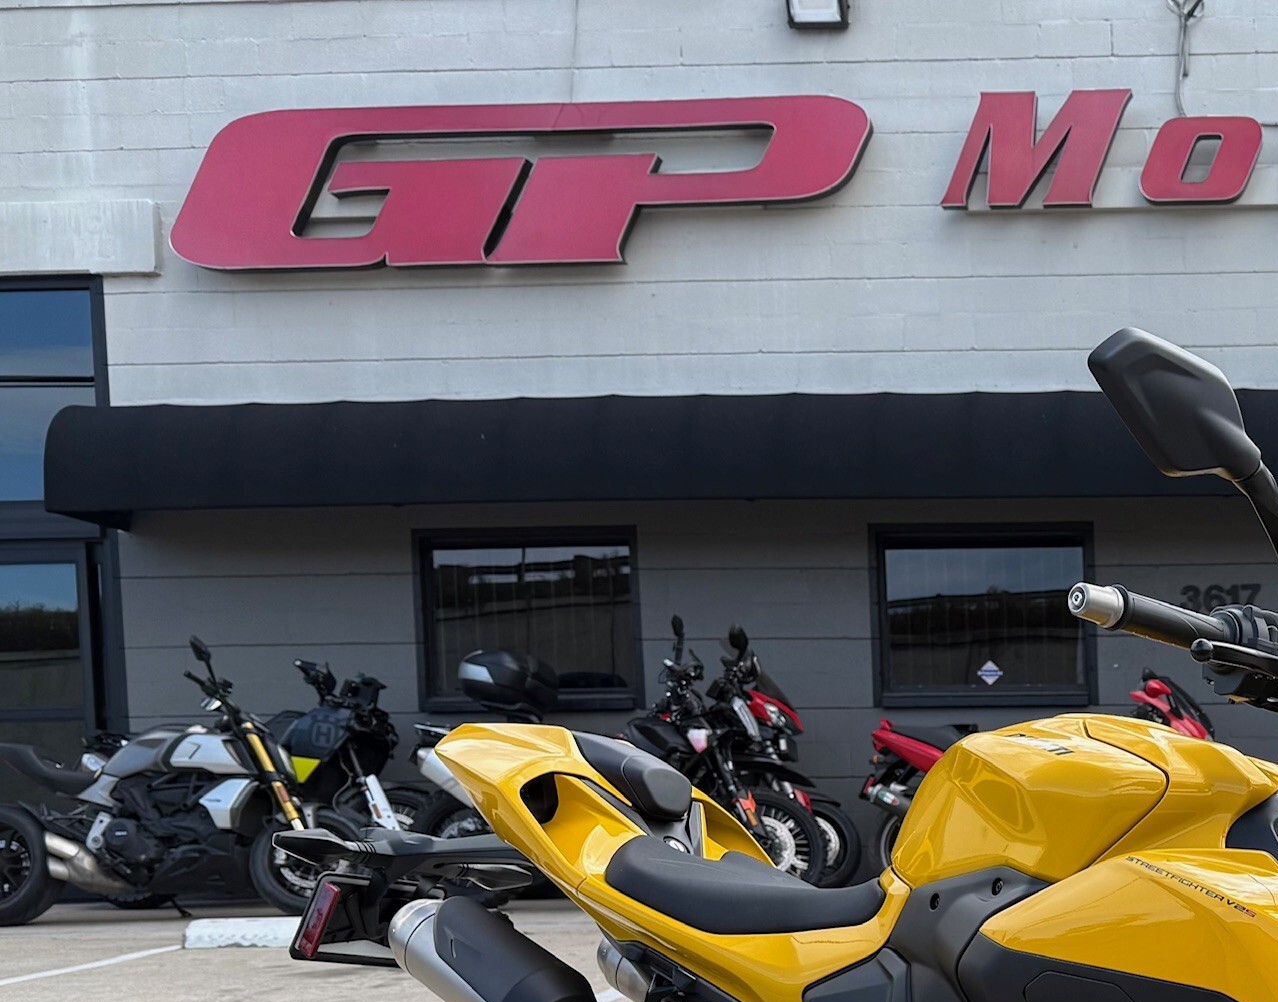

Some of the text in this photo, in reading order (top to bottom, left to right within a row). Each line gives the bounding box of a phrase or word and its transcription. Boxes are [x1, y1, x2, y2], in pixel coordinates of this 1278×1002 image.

[170, 94, 873, 271] GP
[1180, 583, 1262, 613] 3617
[1125, 855, 1225, 902] STREETFIGHTER
